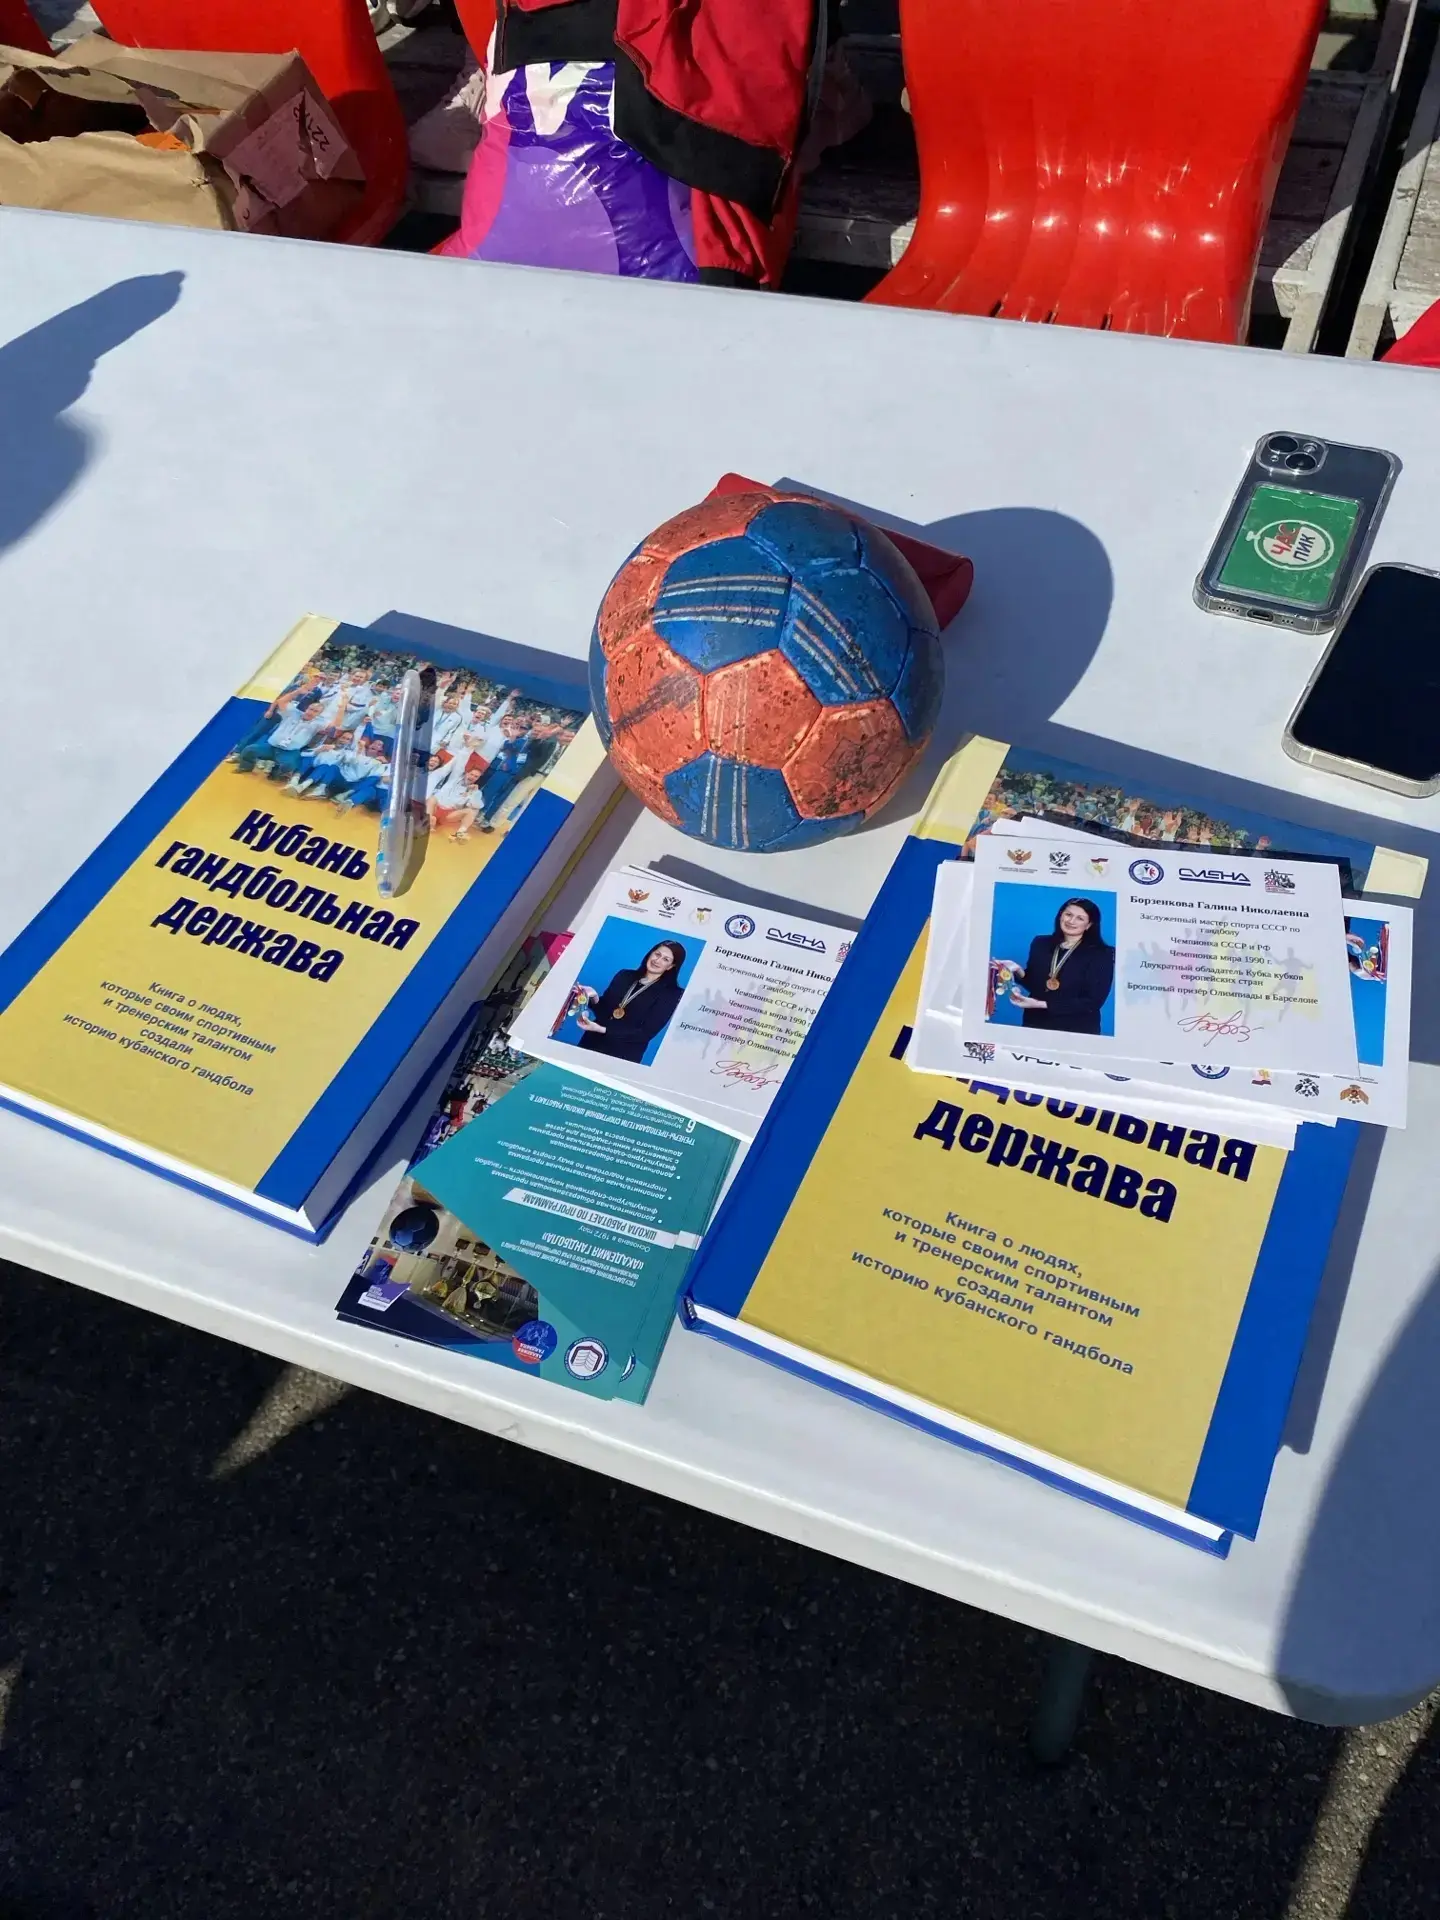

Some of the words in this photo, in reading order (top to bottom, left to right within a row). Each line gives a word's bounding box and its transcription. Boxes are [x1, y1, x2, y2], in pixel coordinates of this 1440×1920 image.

[1270, 523, 1296, 556] ЧАС
[1293, 533, 1316, 562] ПИК
[230, 809, 370, 881] Кубань
[155, 840, 420, 951] гандбольная
[1130, 896, 1194, 909] Борзенкова
[1197, 901, 1237, 912] Галина
[1241, 905, 1309, 918] Николаевна
[1140, 913, 1197, 924] Заслуженный
[1200, 919, 1228, 927] мастер
[1230, 922, 1259, 930] спорта
[1261, 924, 1287, 932] СССР
[1200, 928, 1239, 937] гандболу
[150, 897, 345, 984] держава
[1171, 937, 1218, 948] Чемпионка
[715, 945, 768, 965] Борзенкова
[770, 961, 803, 975] Галина
[1170, 949, 1218, 960] Чемпионка
[1220, 955, 1242, 963] мира
[1245, 956, 1264, 964] 1990
[717, 963, 764, 980] Заслуженный
[766, 976, 790, 988] мастер
[791, 983, 815, 994] спорта
[1140, 961, 1193, 971] Двукратный
[1195, 966, 1243, 976] обладатель
[1246, 970, 1271, 978] Кубка
[1274, 972, 1303, 980] кубков
[1181, 973, 1236, 984] европейских
[148, 981, 185, 1004] Книга
[187, 999, 195, 1007] о
[198, 1001, 243, 1027] людях,
[734, 988, 773, 1004] Чемпионка
[775, 1000, 797, 1009] СССР
[804, 1007, 816, 1015] РФ
[763, 984, 796, 998] гандболу
[1127, 982, 1174, 992] Бронзовый
[1177, 986, 1208, 996] призёр
[1210, 989, 1262, 1000] Олимпиады
[1273, 994, 1319, 1004] Барселоне
[100, 980, 152, 1007] которые
[154, 1000, 193, 1023] своим
[196, 1016, 276, 1054] спортивным
[698, 1004, 742, 1021] Двукратный
[744, 1017, 782, 1033] обладатель
[729, 1000, 767, 1016] Чемпионка
[769, 1012, 788, 1021] мира
[789, 1016, 806, 1026] 1990
[103, 998, 112, 1007] и
[115, 1002, 189, 1038] тренерским
[192, 1030, 252, 1062] талантом
[140, 1027, 193, 1056] создали
[680, 1022, 719, 1037] Бронзовый
[720, 1032, 745, 1045] призёр
[747, 1040, 790, 1057] Олимпиады
[728, 1022, 773, 1039] европейских
[775, 1035, 796, 1045] стран
[63, 1013, 117, 1042] историю
[119, 1036, 190, 1072] кубанского
[192, 1063, 254, 1096] гандбола
[684, 1118, 697, 1134] 6
[914, 1099, 1178, 1224] держава
[520, 1192, 576, 1216] ПРОГРАММАМ:
[575, 1208, 588, 1220] ПО
[588, 1212, 627, 1232] РАБОТАЕТ
[593, 1229, 610, 1240] 1972
[626, 1223, 657, 1240] ШКОЛА
[541, 1229, 592, 1255] ГАНДБОЛА»
[616, 1236, 650, 1252] Основана
[944, 1210, 996, 1244] Книга
[1002, 1236, 1013, 1249] о
[1018, 1239, 1083, 1278] людях,
[591, 1244, 644, 1271] «АКАДЕМИЯ
[882, 1206, 956, 1245] которые
[962, 1235, 1019, 1266] своим
[1024, 1260, 1140, 1318] спортивным
[895, 1229, 906, 1242] и
[912, 1236, 1018, 1288] тренерским
[1024, 1279, 1114, 1327] талантом
[956, 1273, 1034, 1315] создали
[852, 1250, 930, 1291] историю
[934, 1284, 1038, 1338] кубанского
[1042, 1328, 1134, 1375] гандбола
